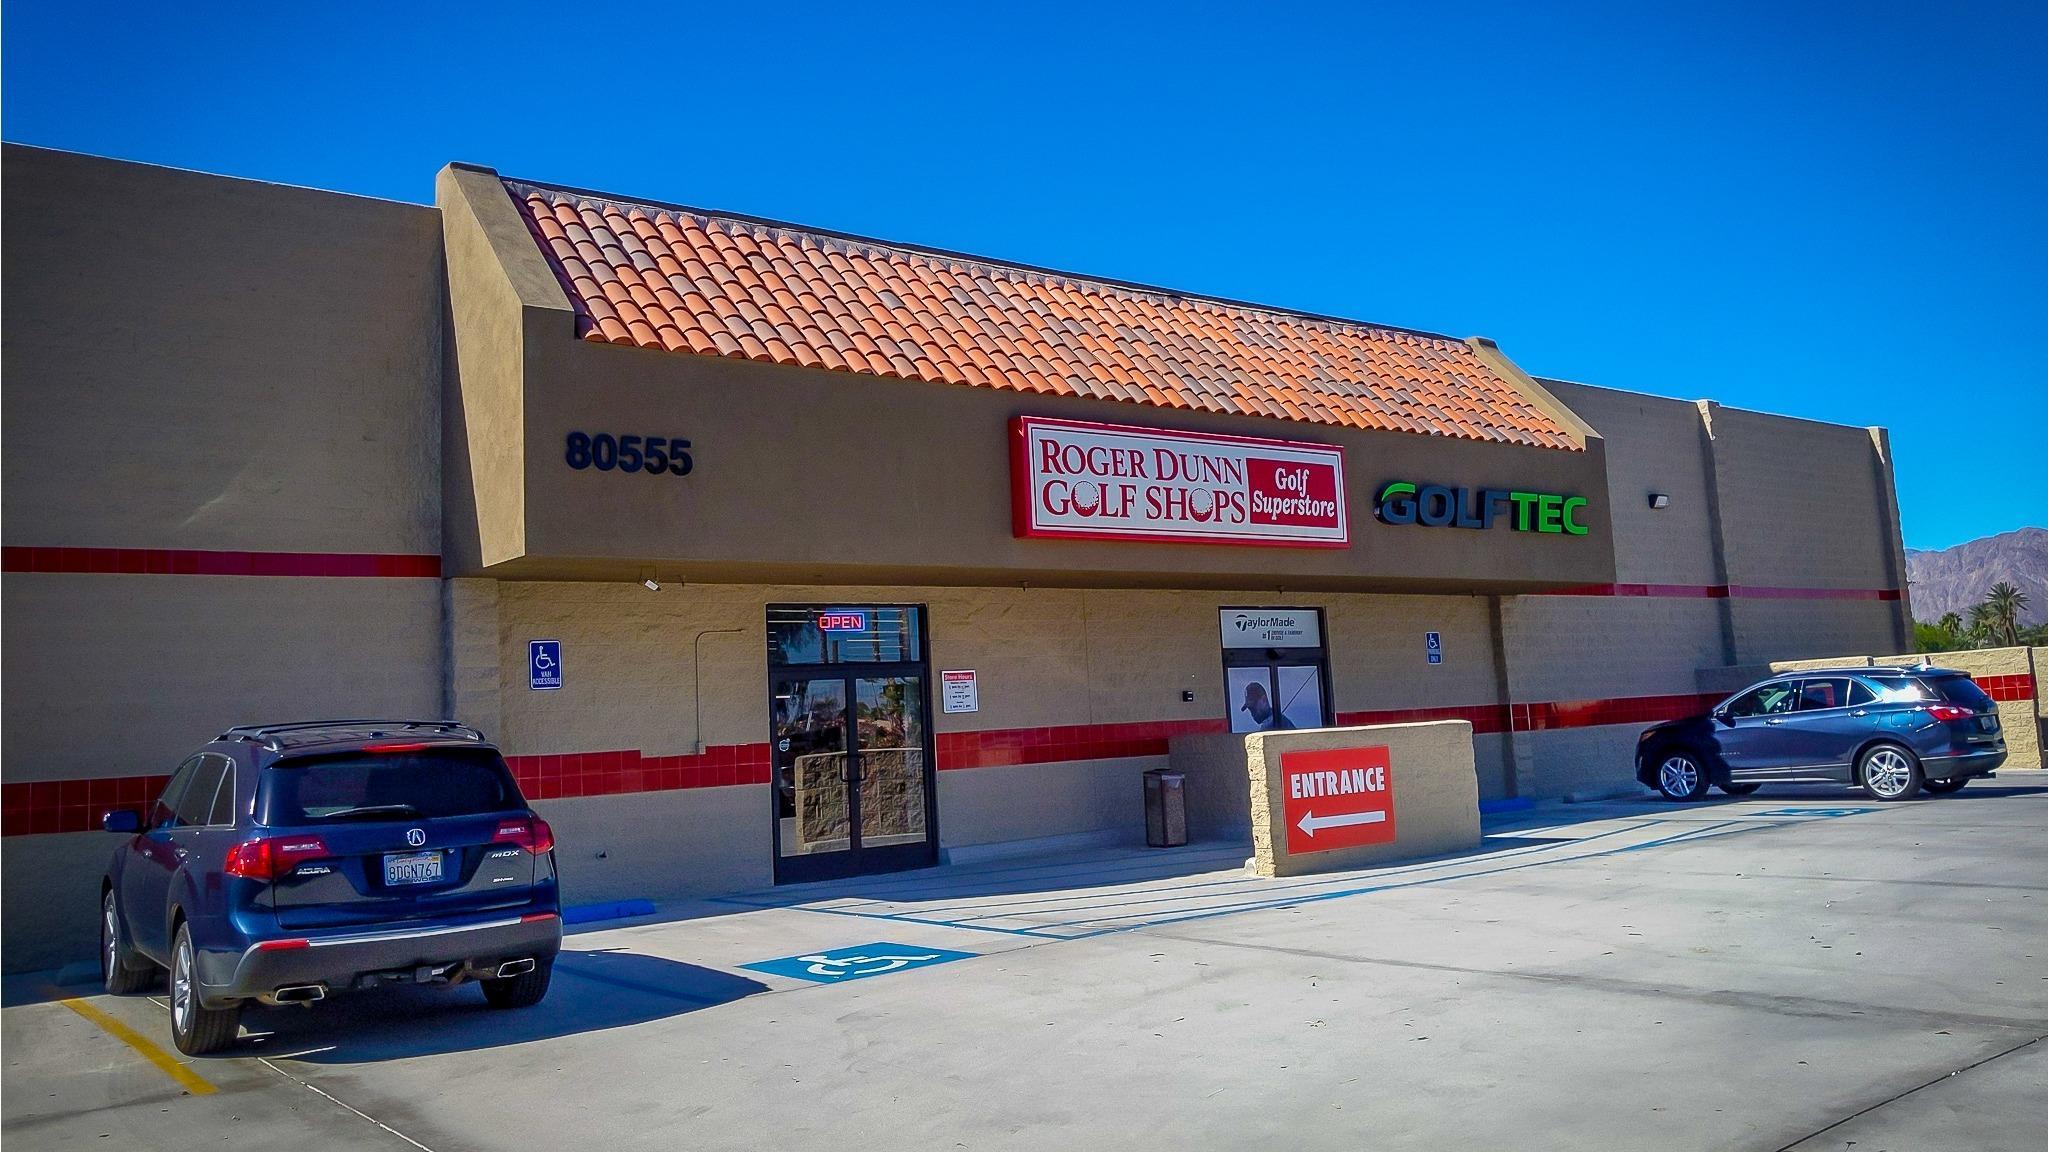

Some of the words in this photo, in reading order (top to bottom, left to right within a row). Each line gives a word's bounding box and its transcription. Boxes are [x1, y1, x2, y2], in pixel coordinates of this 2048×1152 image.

[565, 431, 694, 477] 80555
[1039, 438, 1149, 480] ROGER
[1152, 448, 1244, 485] DUNN
[1275, 467, 1311, 498] Golf
[1042, 479, 1137, 518] GOLF
[1146, 485, 1247, 524] SHOPS
[1253, 490, 1335, 521] Superstore
[1380, 482, 1589, 536] GOLFTEC
[819, 615, 862, 630] OPEN
[1235, 614, 1295, 632] TaylorMade
[1290, 766, 1386, 799] ENTRANCE
